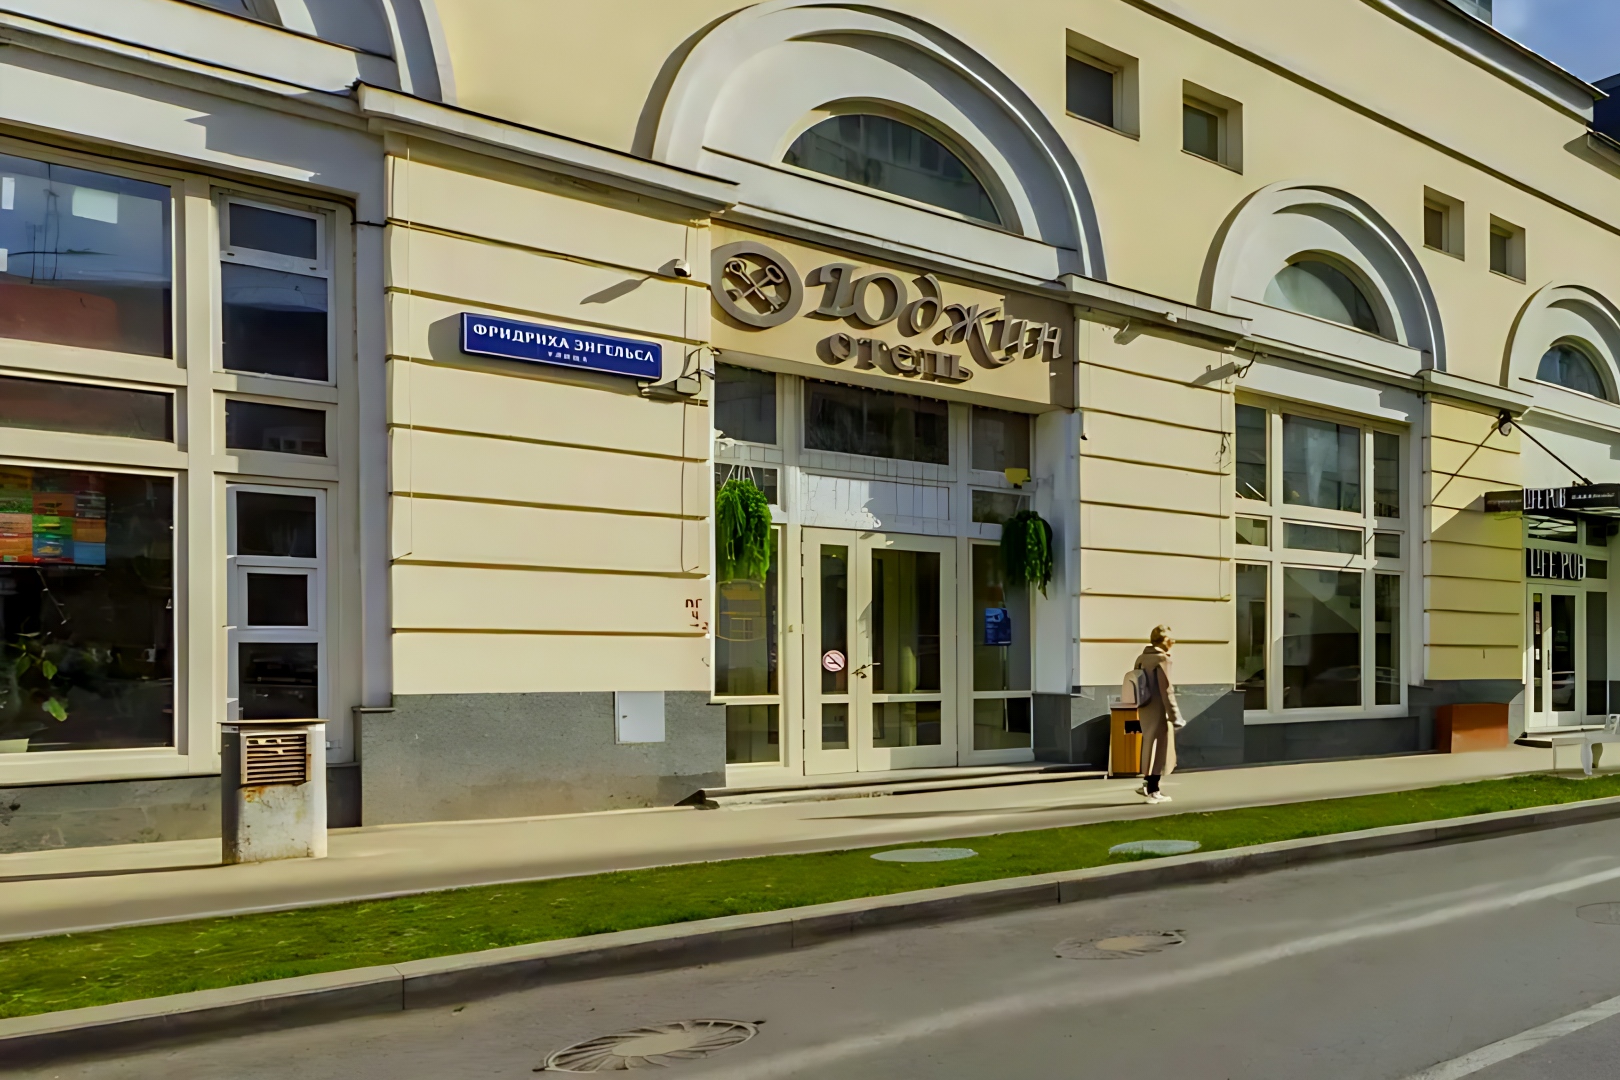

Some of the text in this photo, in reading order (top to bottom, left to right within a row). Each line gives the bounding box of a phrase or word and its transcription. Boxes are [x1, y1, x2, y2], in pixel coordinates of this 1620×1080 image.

[804, 262, 1062, 369] Юджин
[473, 323, 655, 363] ФРИДРИХА ЭНГЕЛЬСА
[1523, 488, 1544, 510] LIFE
[1530, 548, 1558, 579] LIFE
